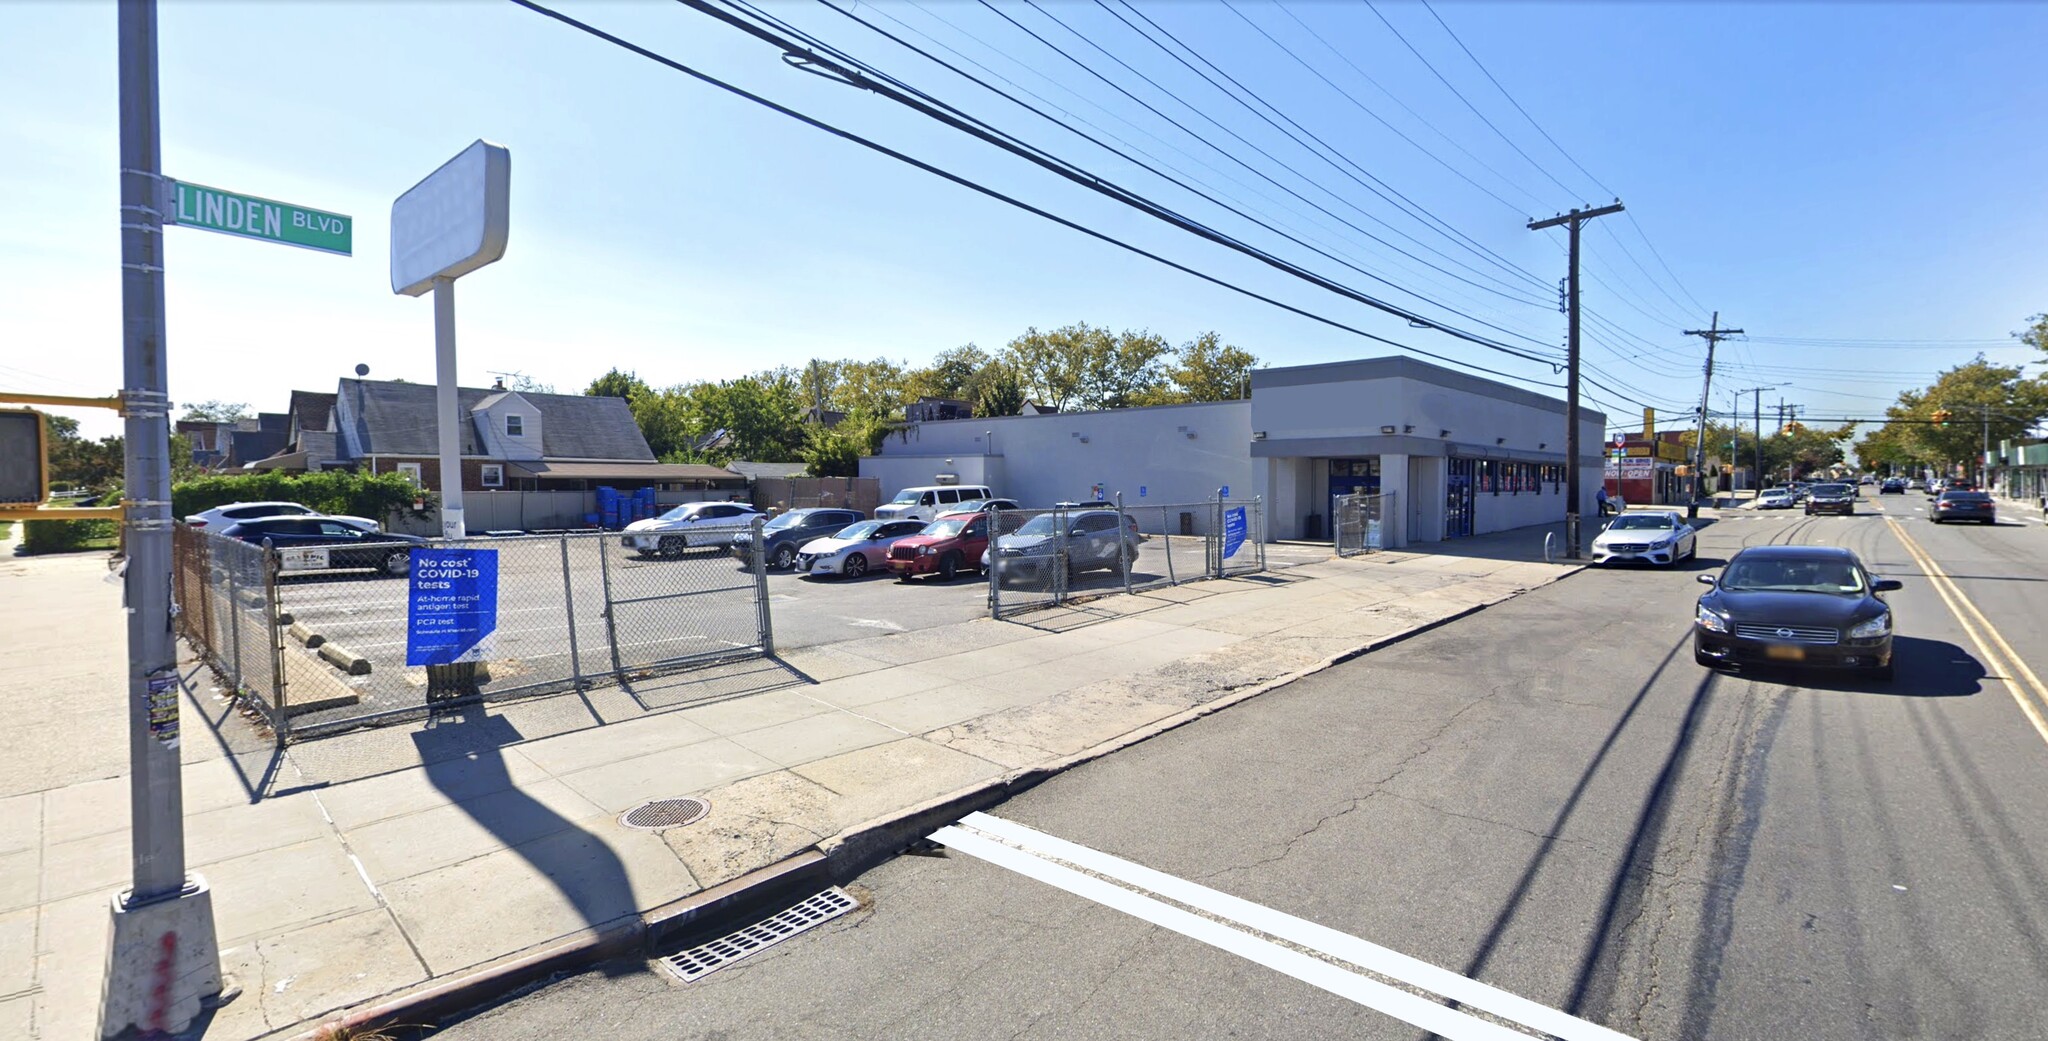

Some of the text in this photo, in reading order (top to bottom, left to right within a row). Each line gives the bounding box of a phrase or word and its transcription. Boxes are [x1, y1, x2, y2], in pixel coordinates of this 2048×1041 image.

[178, 187, 344, 238] LINDEN BLVD
[1627, 470, 1650, 478] OPEN
[419, 558, 437, 568] No
[418, 569, 480, 578] COVID-19
[417, 580, 451, 589] tests
[457, 594, 480, 603] rapid
[417, 603, 451, 611] antigen
[416, 618, 436, 626] PCR
